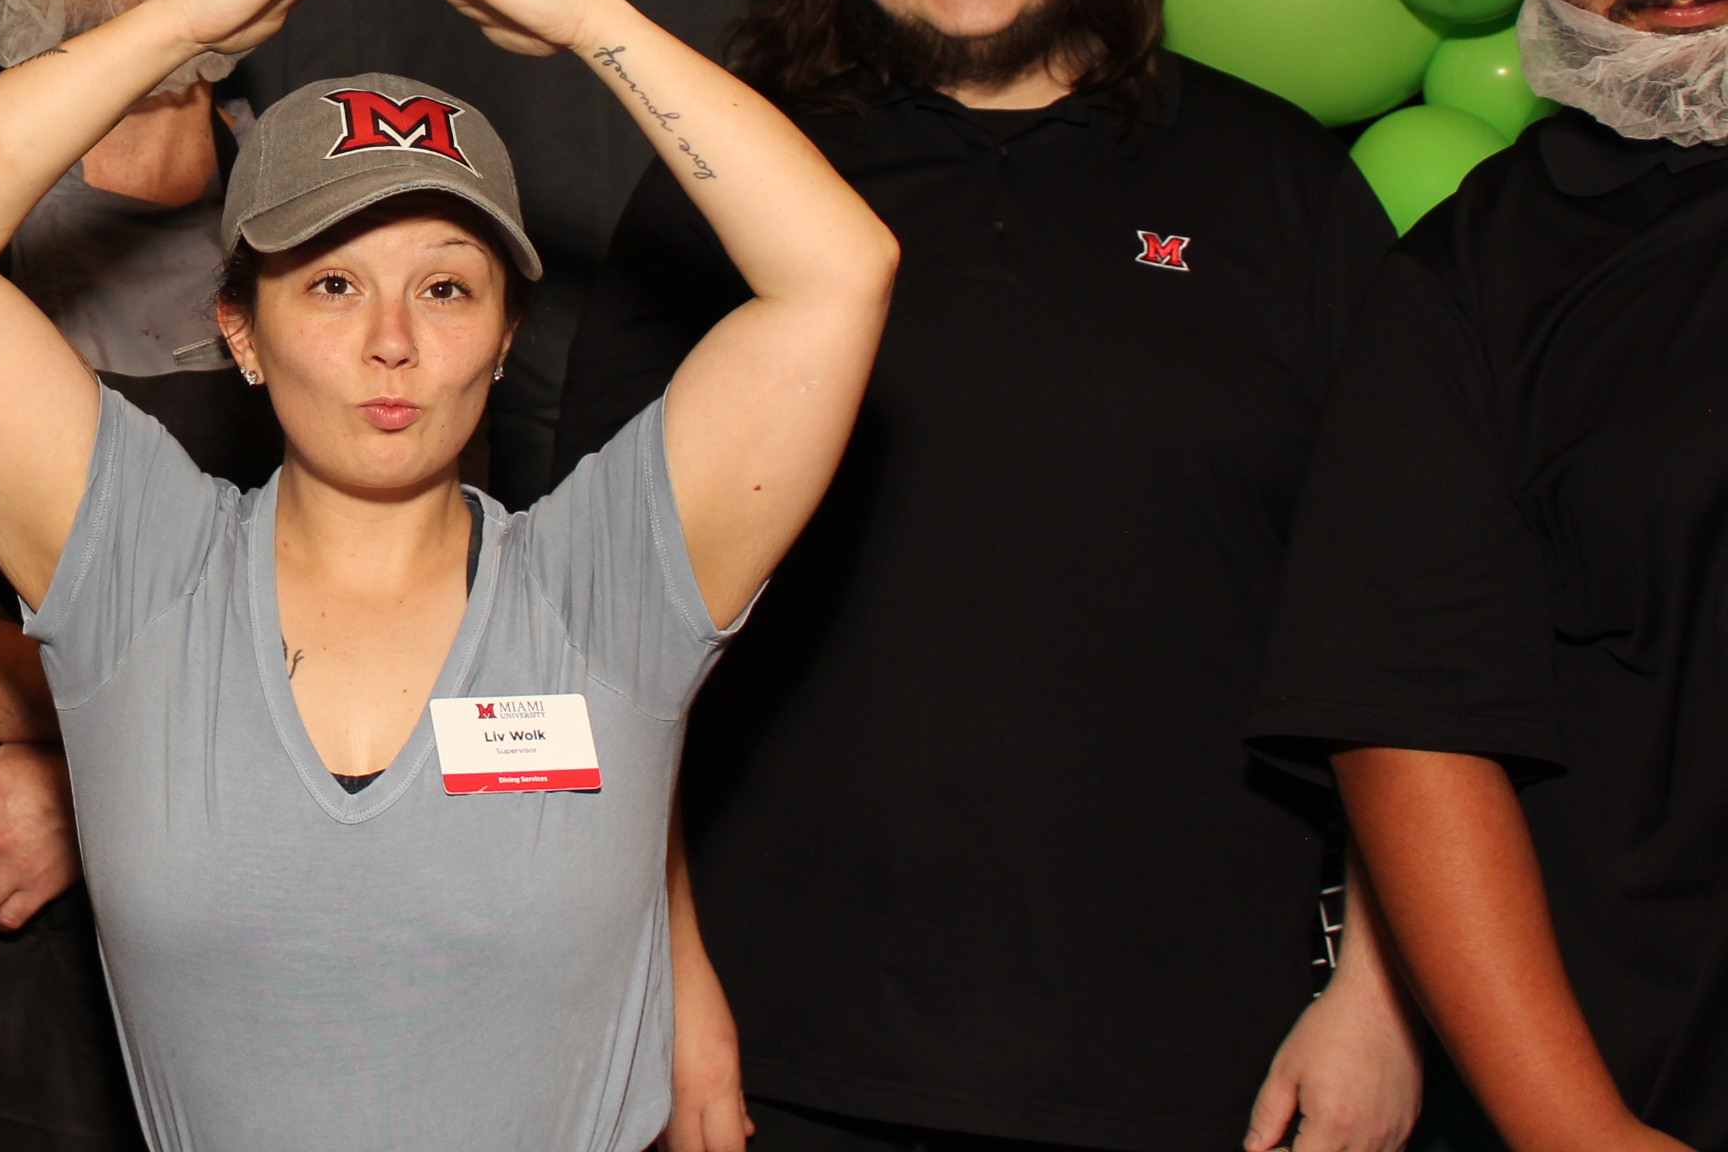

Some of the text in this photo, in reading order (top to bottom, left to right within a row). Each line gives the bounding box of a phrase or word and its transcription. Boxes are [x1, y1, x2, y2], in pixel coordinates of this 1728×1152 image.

[593, 46, 717, 180] love yourself
[320, 88, 480, 178] M
[1135, 230, 1191, 271] M
[475, 703, 497, 720] M
[499, 701, 545, 712] MIAMI
[500, 711, 546, 720] UNIVERSITY
[484, 730, 547, 742] Liv Wolk
[496, 747, 538, 755] Supervisor
[498, 775, 549, 784] Dining Services
